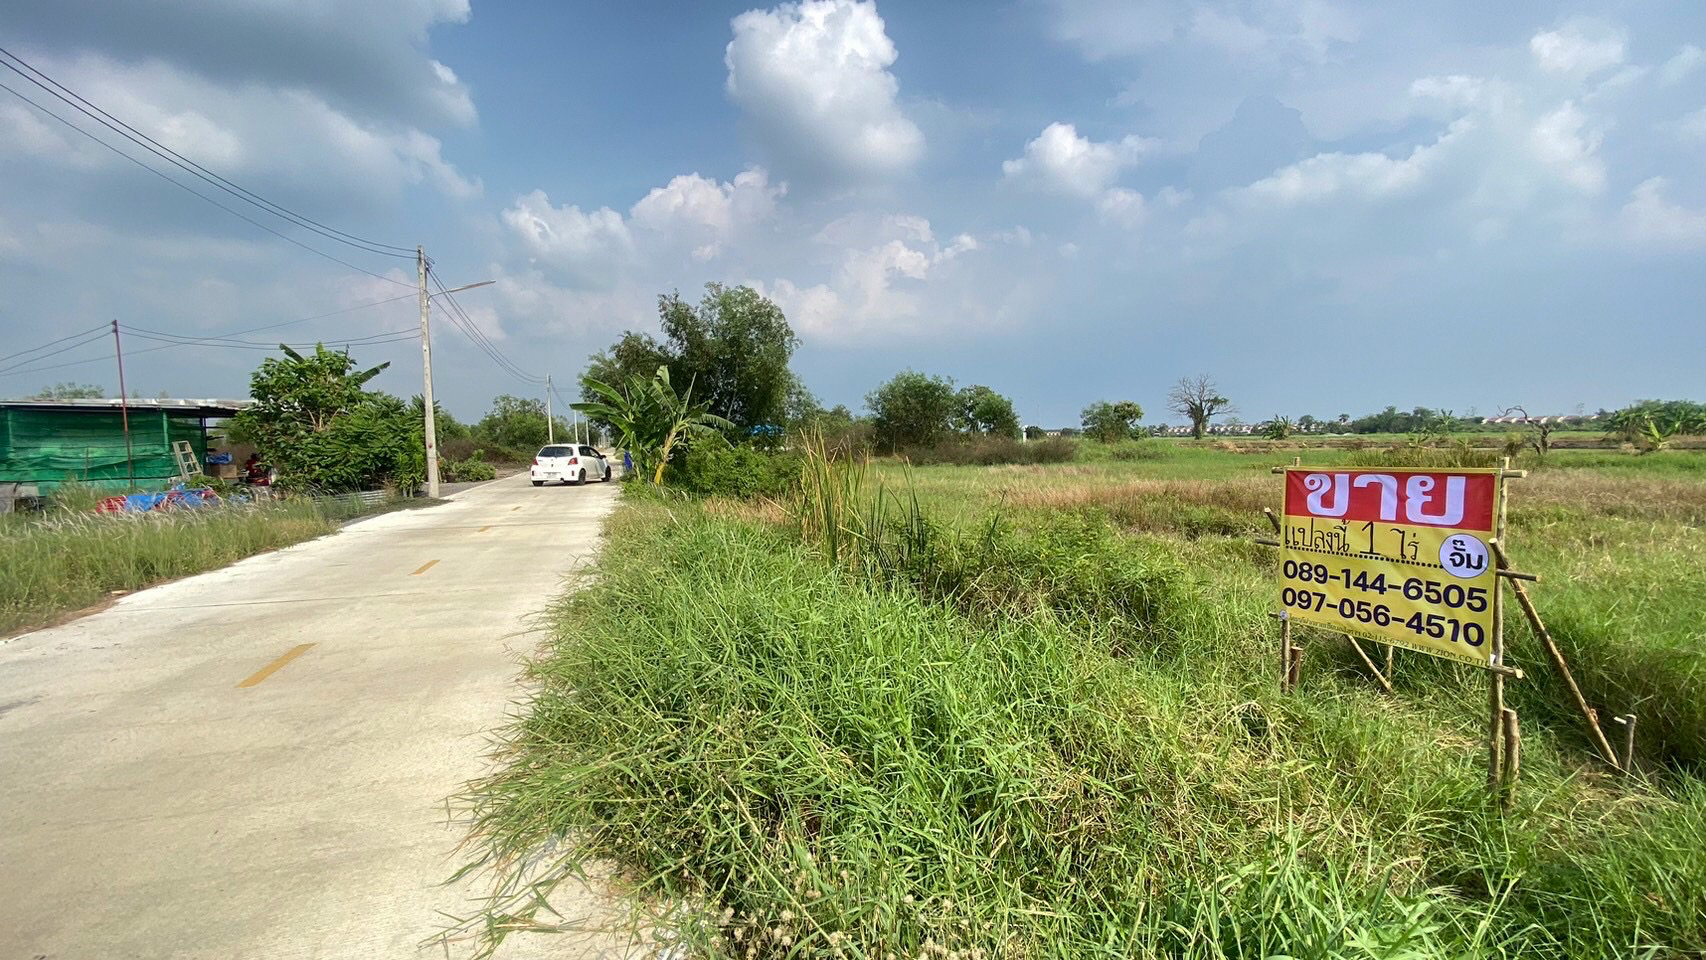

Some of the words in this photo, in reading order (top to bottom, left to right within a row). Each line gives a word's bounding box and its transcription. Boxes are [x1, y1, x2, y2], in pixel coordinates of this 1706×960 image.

[1303, 473, 1466, 526] ขาย
[1284, 517, 1350, 552] แปลงนี้
[1360, 521, 1381, 555] 1
[1390, 527, 1420, 560] ไร่
[1283, 560, 1488, 613] 089-144-6505
[1282, 587, 1485, 647] 097-056-4510
